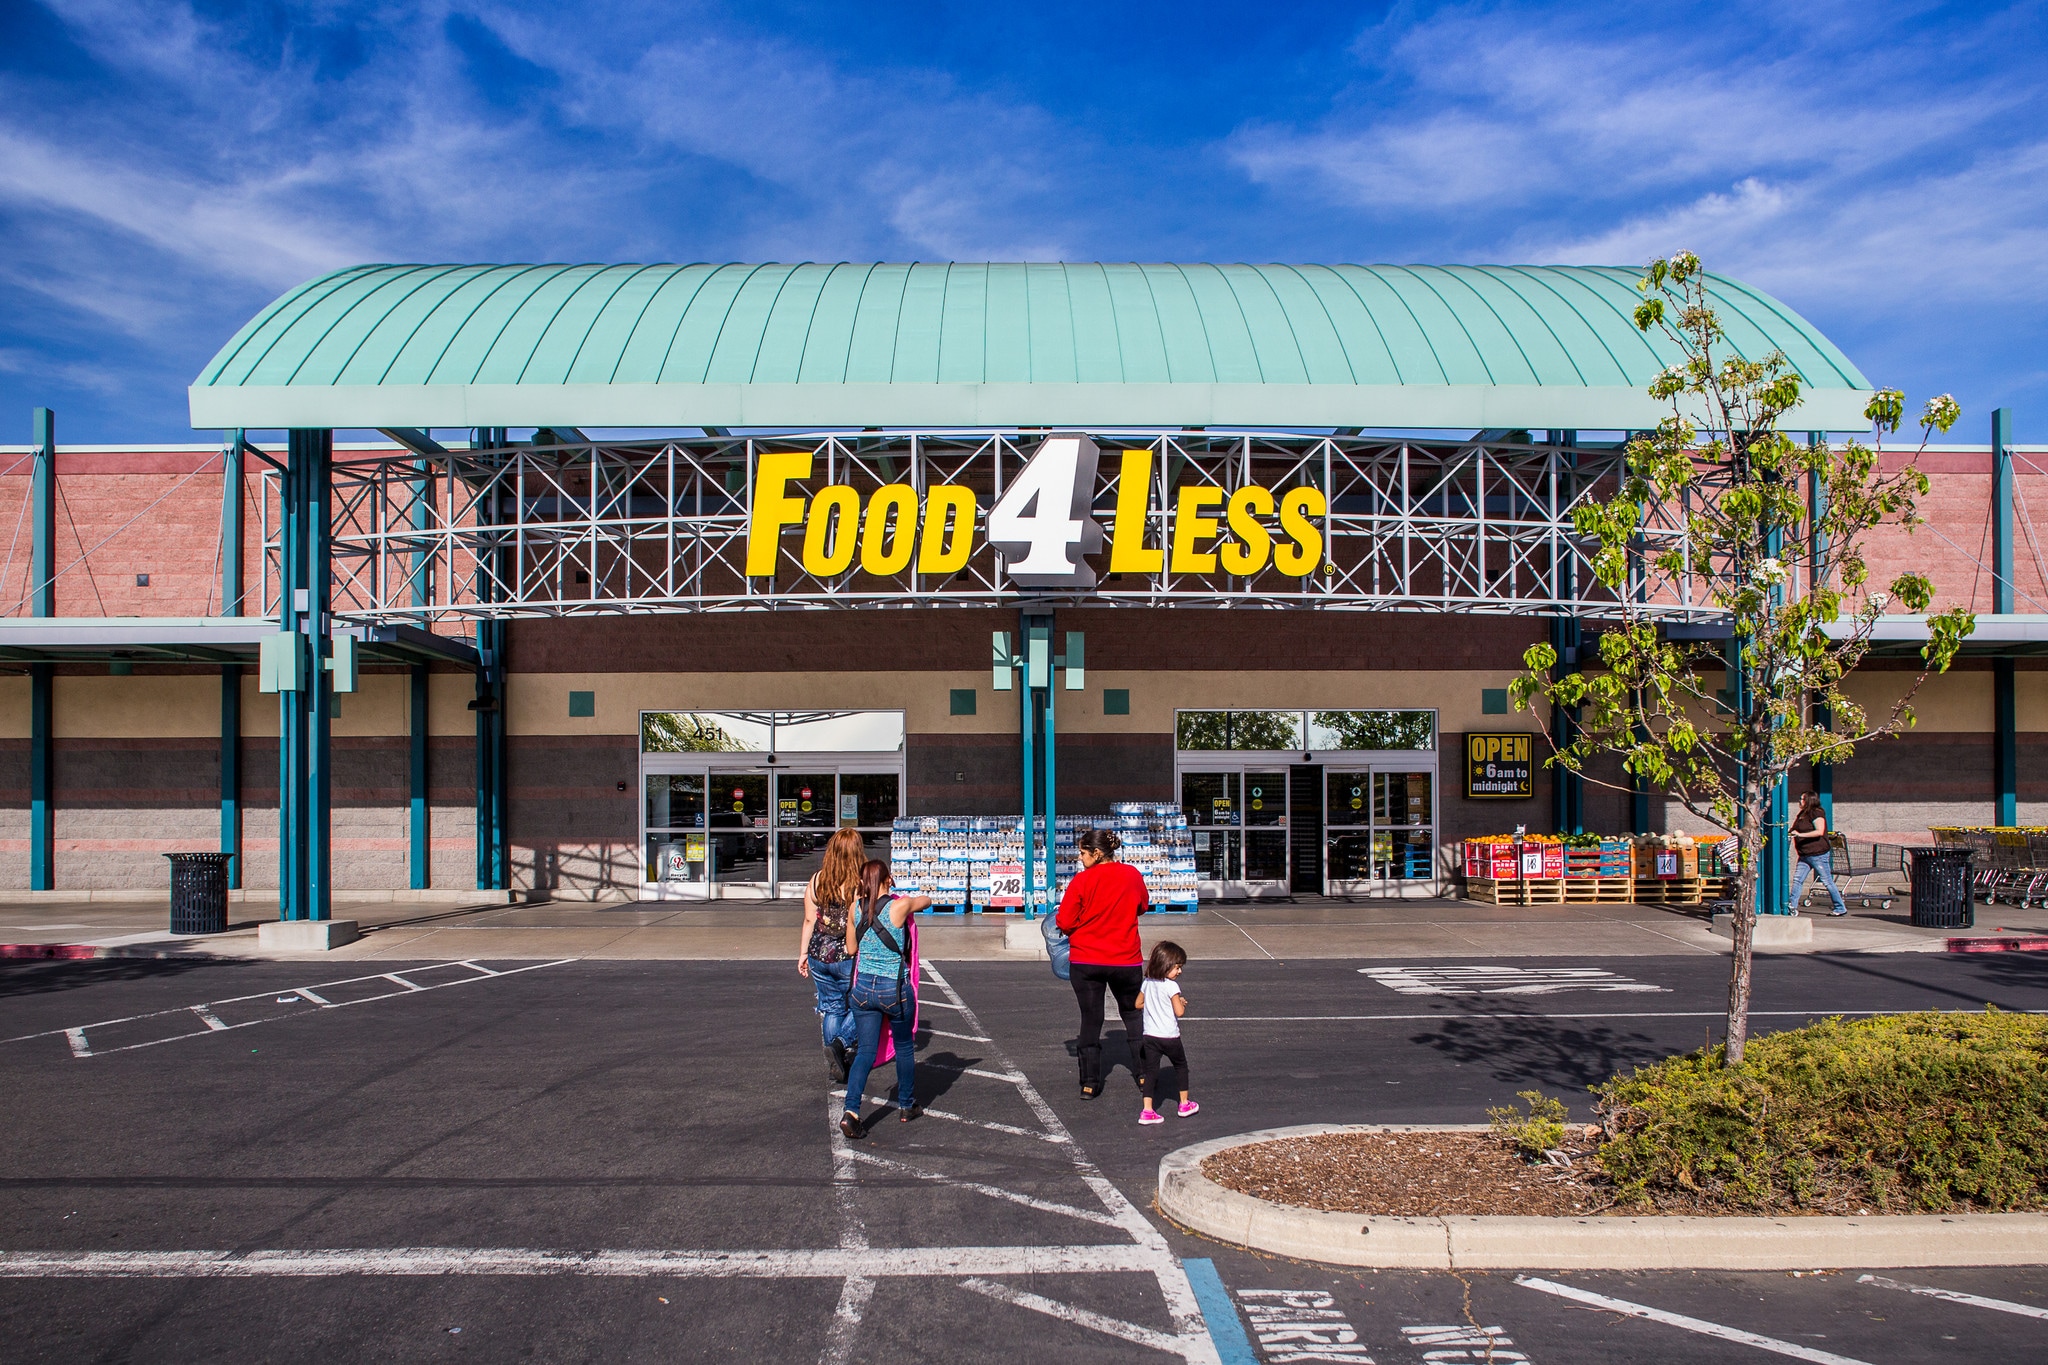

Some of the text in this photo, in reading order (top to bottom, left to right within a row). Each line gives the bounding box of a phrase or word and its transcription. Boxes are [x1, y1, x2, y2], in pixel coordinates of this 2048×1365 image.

[746, 436, 1326, 578] FOOD 4 LESS
[693, 727, 722, 740] 451
[1471, 737, 1528, 761] OPEN
[1516, 768, 1528, 778] to
[1472, 780, 1518, 793] midnight
[780, 801, 796, 809] OPEN
[992, 878, 1021, 896] 248
[1356, 966, 1674, 995] STOP
